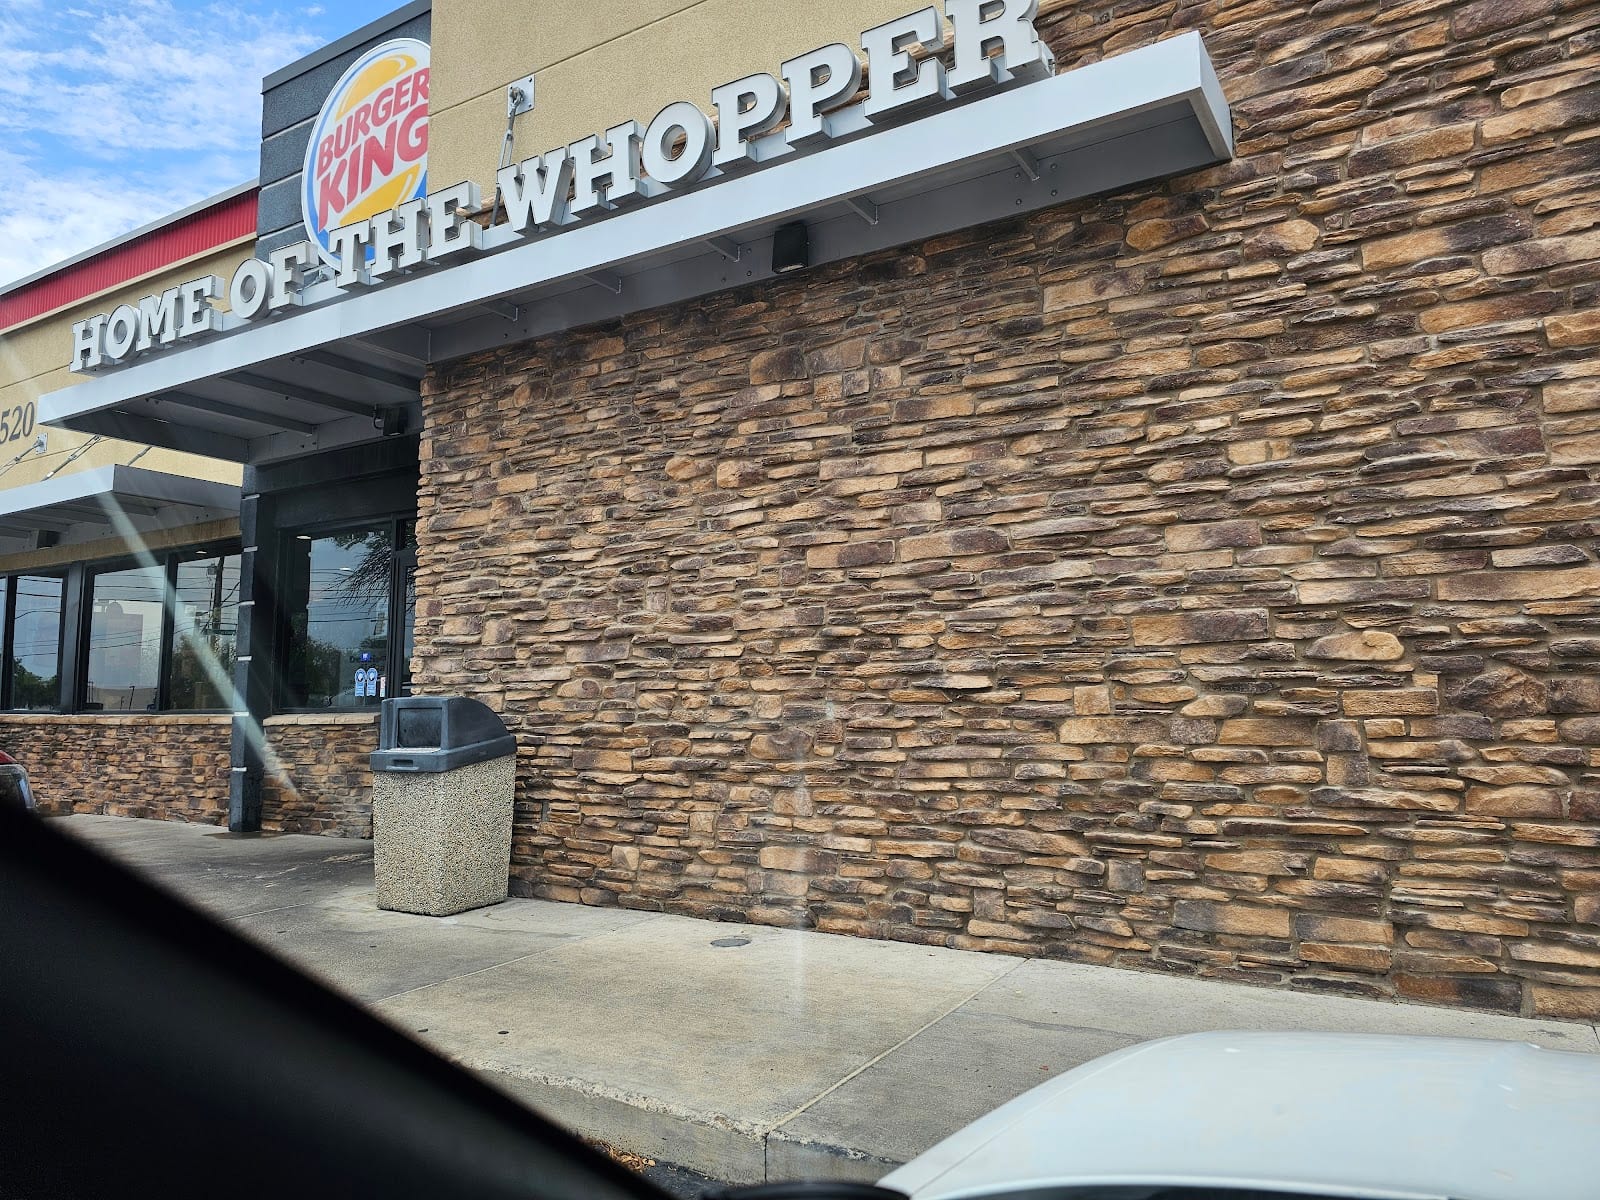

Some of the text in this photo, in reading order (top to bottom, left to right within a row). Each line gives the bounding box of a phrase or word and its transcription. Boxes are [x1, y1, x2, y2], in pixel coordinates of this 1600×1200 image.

[317, 67, 430, 180] BURGER
[318, 104, 428, 232] KING
[69, 0, 1051, 374] HOME OF THE WHOPPER
[0, 401, 35, 444] 520
